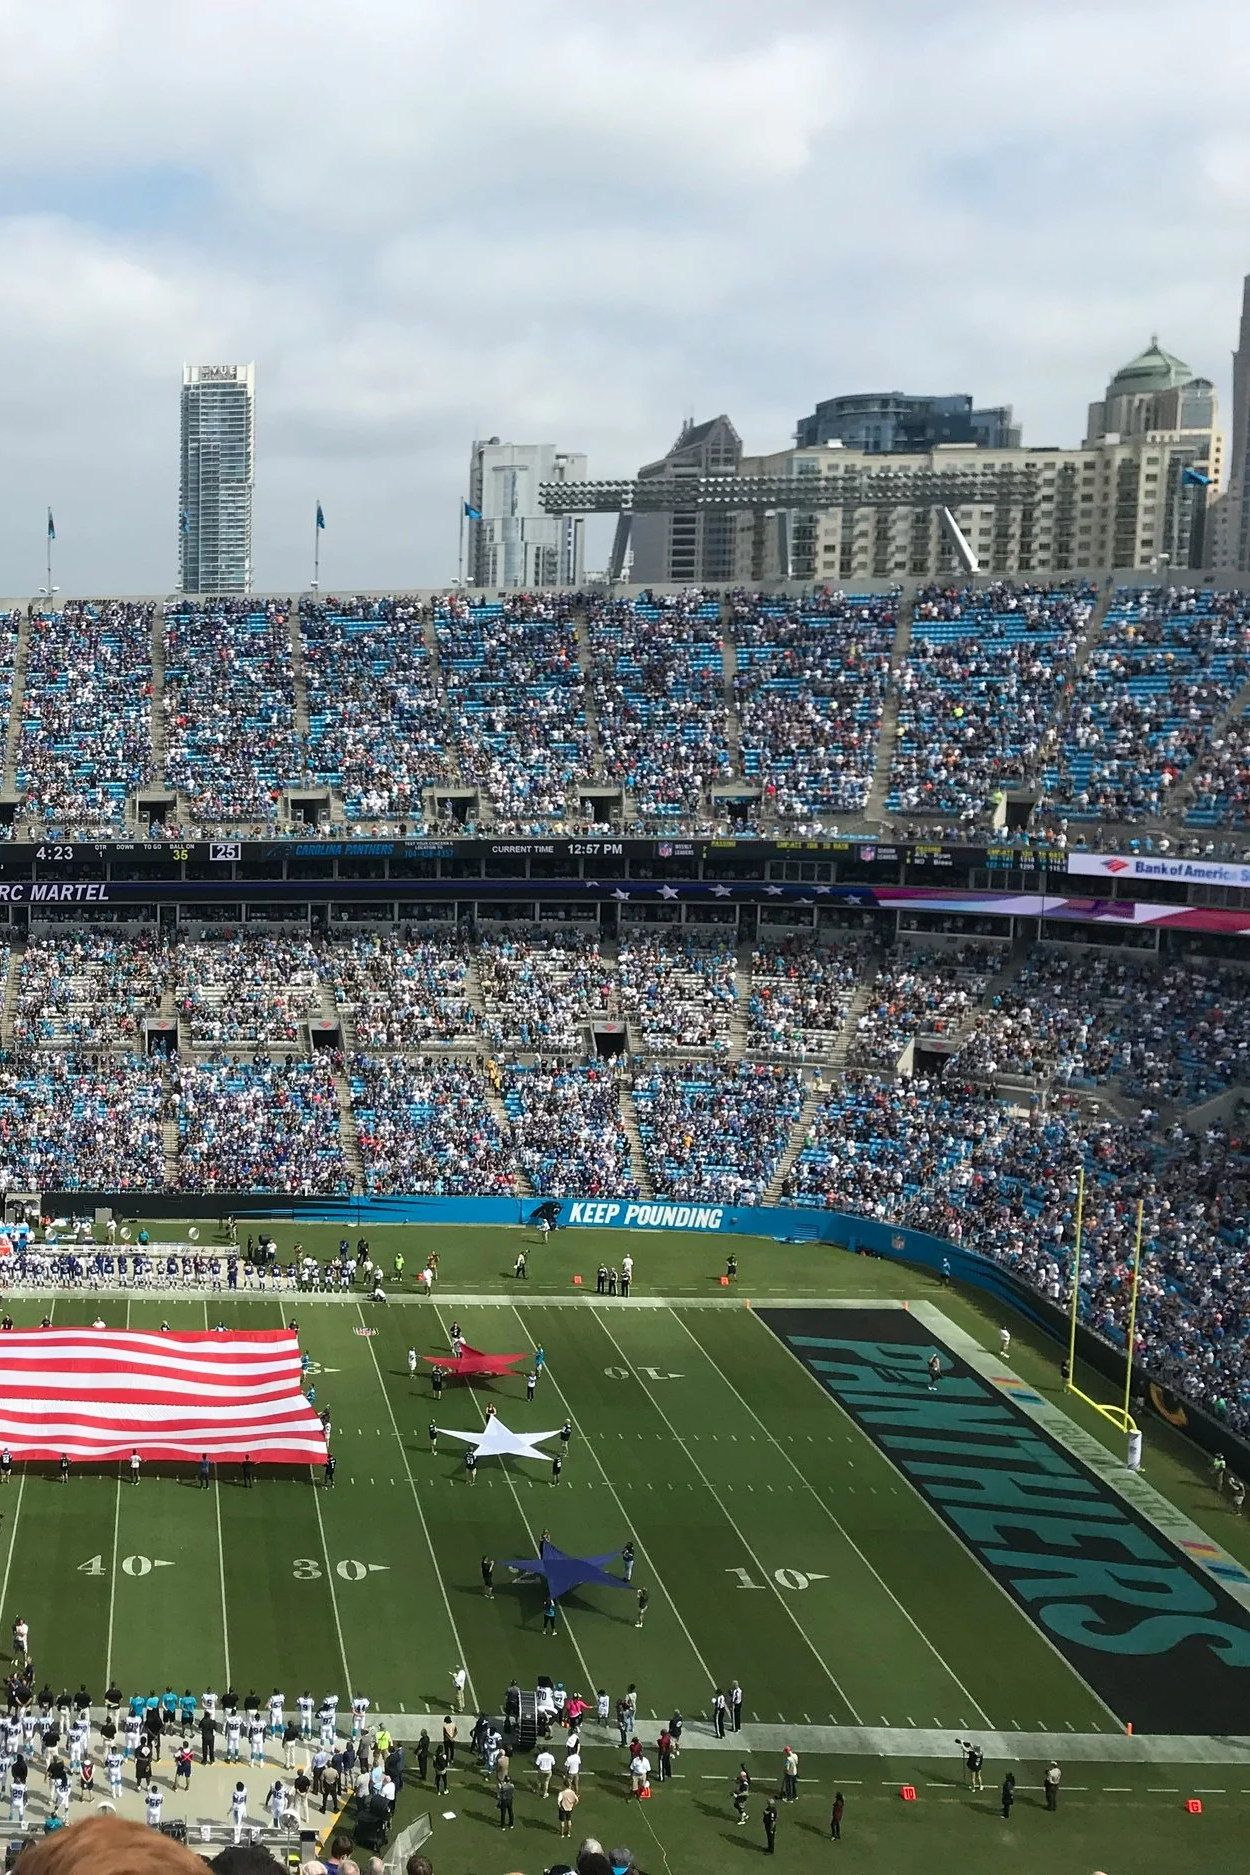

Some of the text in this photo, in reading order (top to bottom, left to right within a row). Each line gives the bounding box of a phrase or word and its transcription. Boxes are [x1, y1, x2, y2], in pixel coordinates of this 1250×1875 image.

[36, 846, 75, 861] 4:23
[98, 851, 104, 859] 1
[173, 849, 190, 861] 35
[216, 845, 237, 859] 25
[295, 844, 396, 857] CAROLINA PANTHERS
[491, 845, 554, 854] CURRENT TIME
[567, 844, 624, 855] 12:57 PM
[674, 849, 695, 857] LEADERS
[1135, 861, 1167, 875] Bank
[1169, 863, 1183, 876] of
[1184, 865, 1237, 881] Americ
[30, 884, 110, 901] MARTEL
[568, 1202, 723, 1230] KEEP POUNDING
[786, 1335, 1250, 1669] PANTHERS
[1110, 1477, 1189, 1527] CATCH
[76, 1554, 153, 1578] 40
[291, 1558, 367, 1581] 30
[723, 1567, 812, 1591] 10
[12, 1789, 24, 1799] 29
[1190, 1801, 1200, 1812] G
